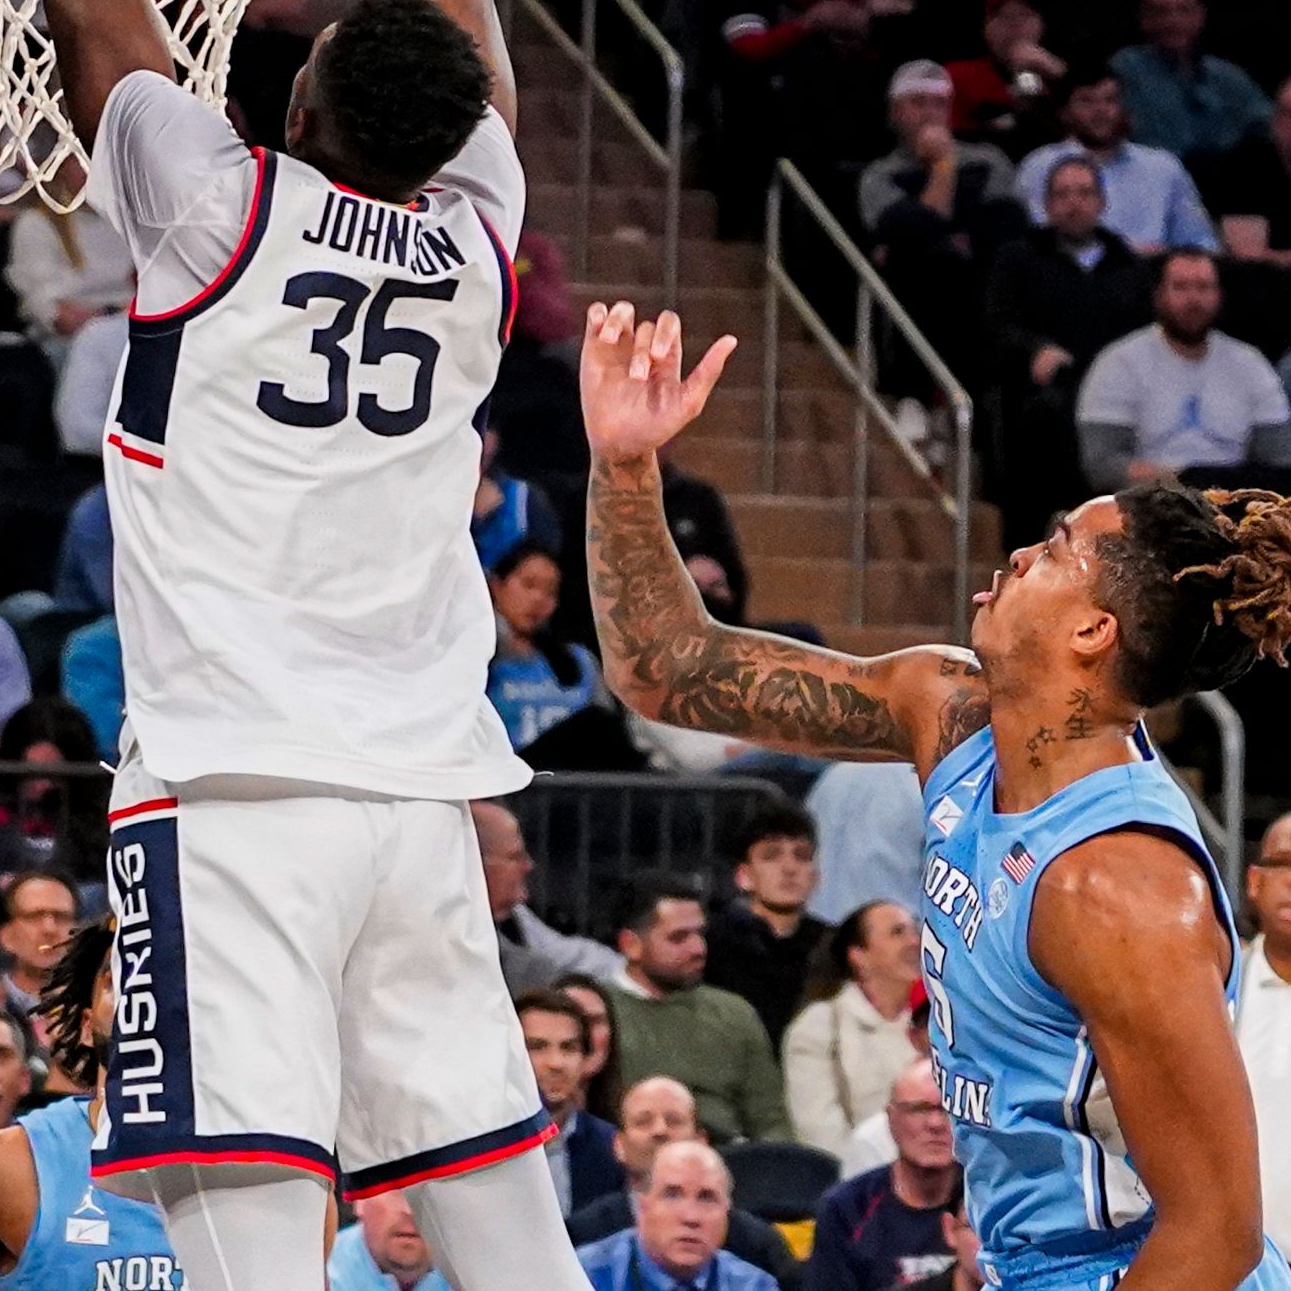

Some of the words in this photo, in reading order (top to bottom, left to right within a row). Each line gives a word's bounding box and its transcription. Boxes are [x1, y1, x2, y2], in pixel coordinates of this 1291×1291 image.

[302, 191, 467, 276] JOHNON
[256, 271, 460, 437] 35
[925, 853, 982, 952] ORTH
[115, 842, 167, 1124] HUSKIES
[921, 917, 956, 1050] 5
